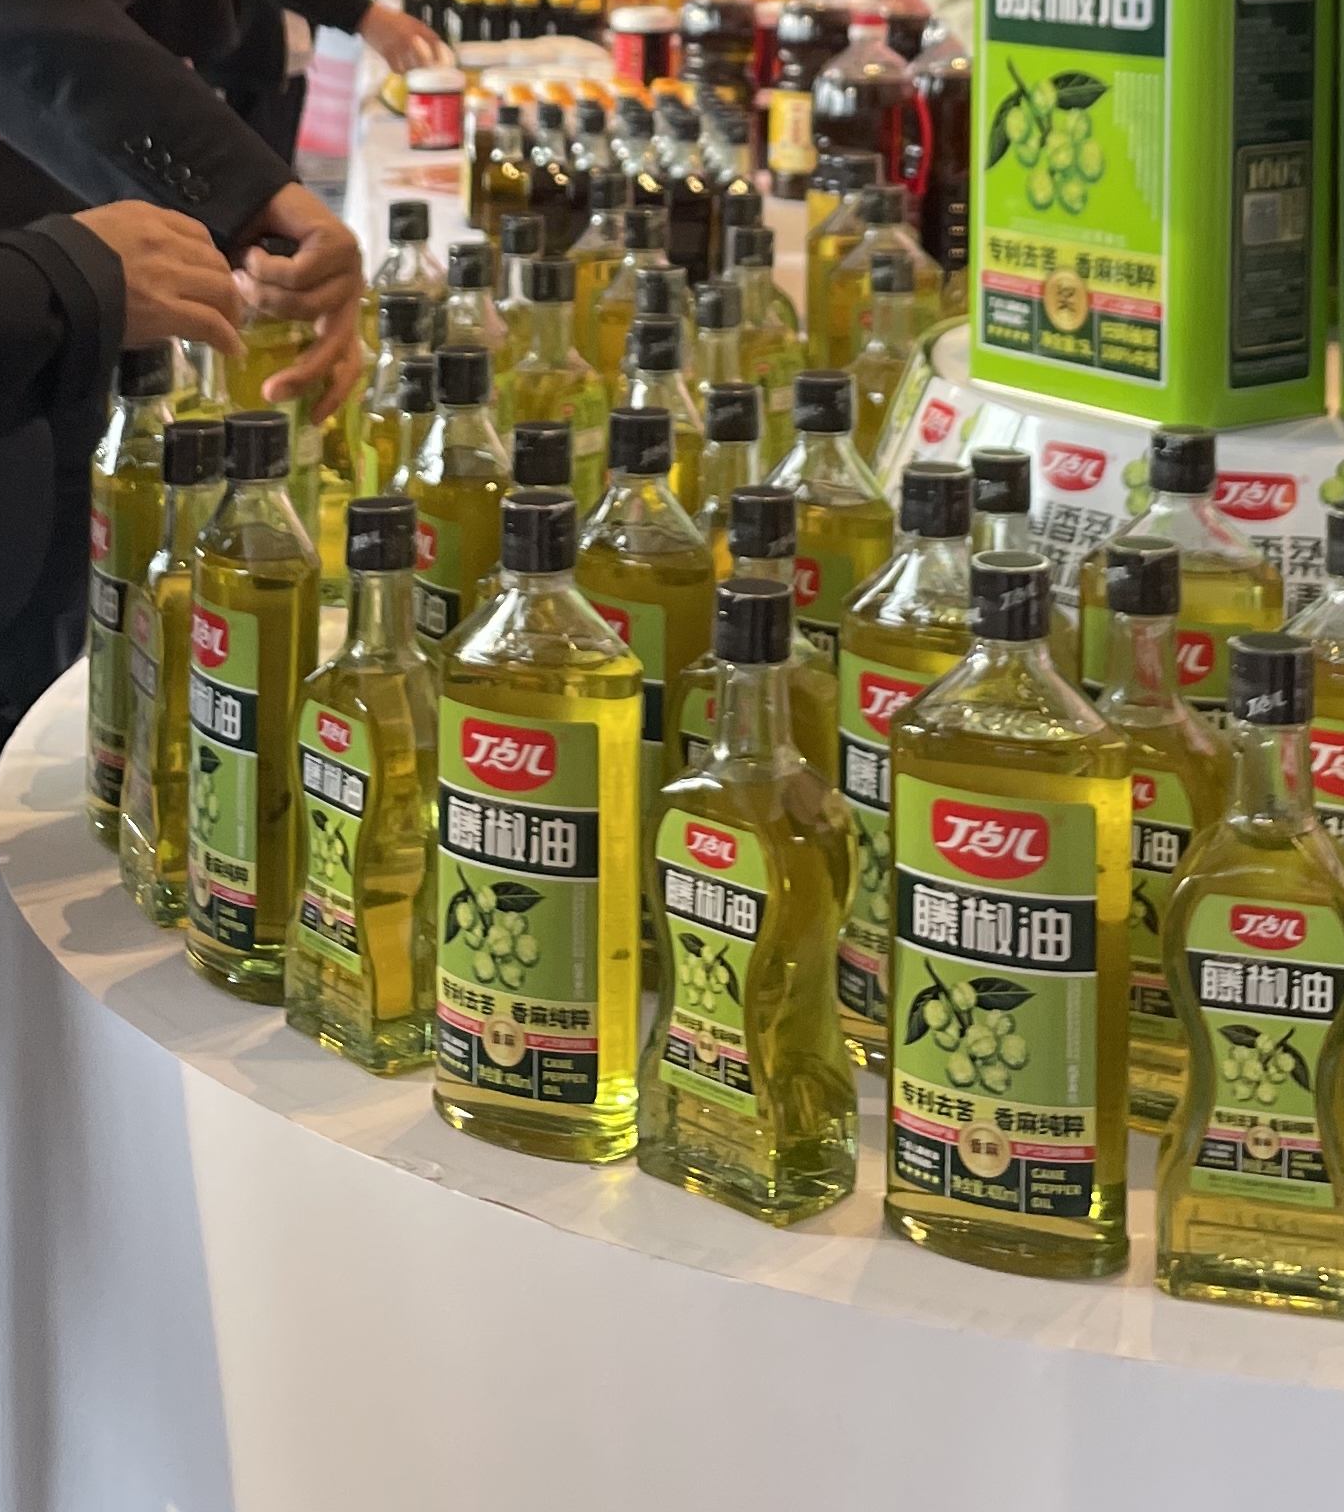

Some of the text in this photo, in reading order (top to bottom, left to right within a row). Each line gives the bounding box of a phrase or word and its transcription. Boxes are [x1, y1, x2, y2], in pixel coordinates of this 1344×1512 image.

[463, 731, 553, 778] 丁点儿
[447, 795, 578, 869] 藤椒油
[934, 814, 1045, 864] 丁点儿
[664, 868, 759, 935] 藤椒油
[912, 883, 1073, 963] 藤椒油
[1200, 958, 1335, 1014] 藤椒油
[901, 1079, 1087, 1139] 专利去苦 香麻纯粹
